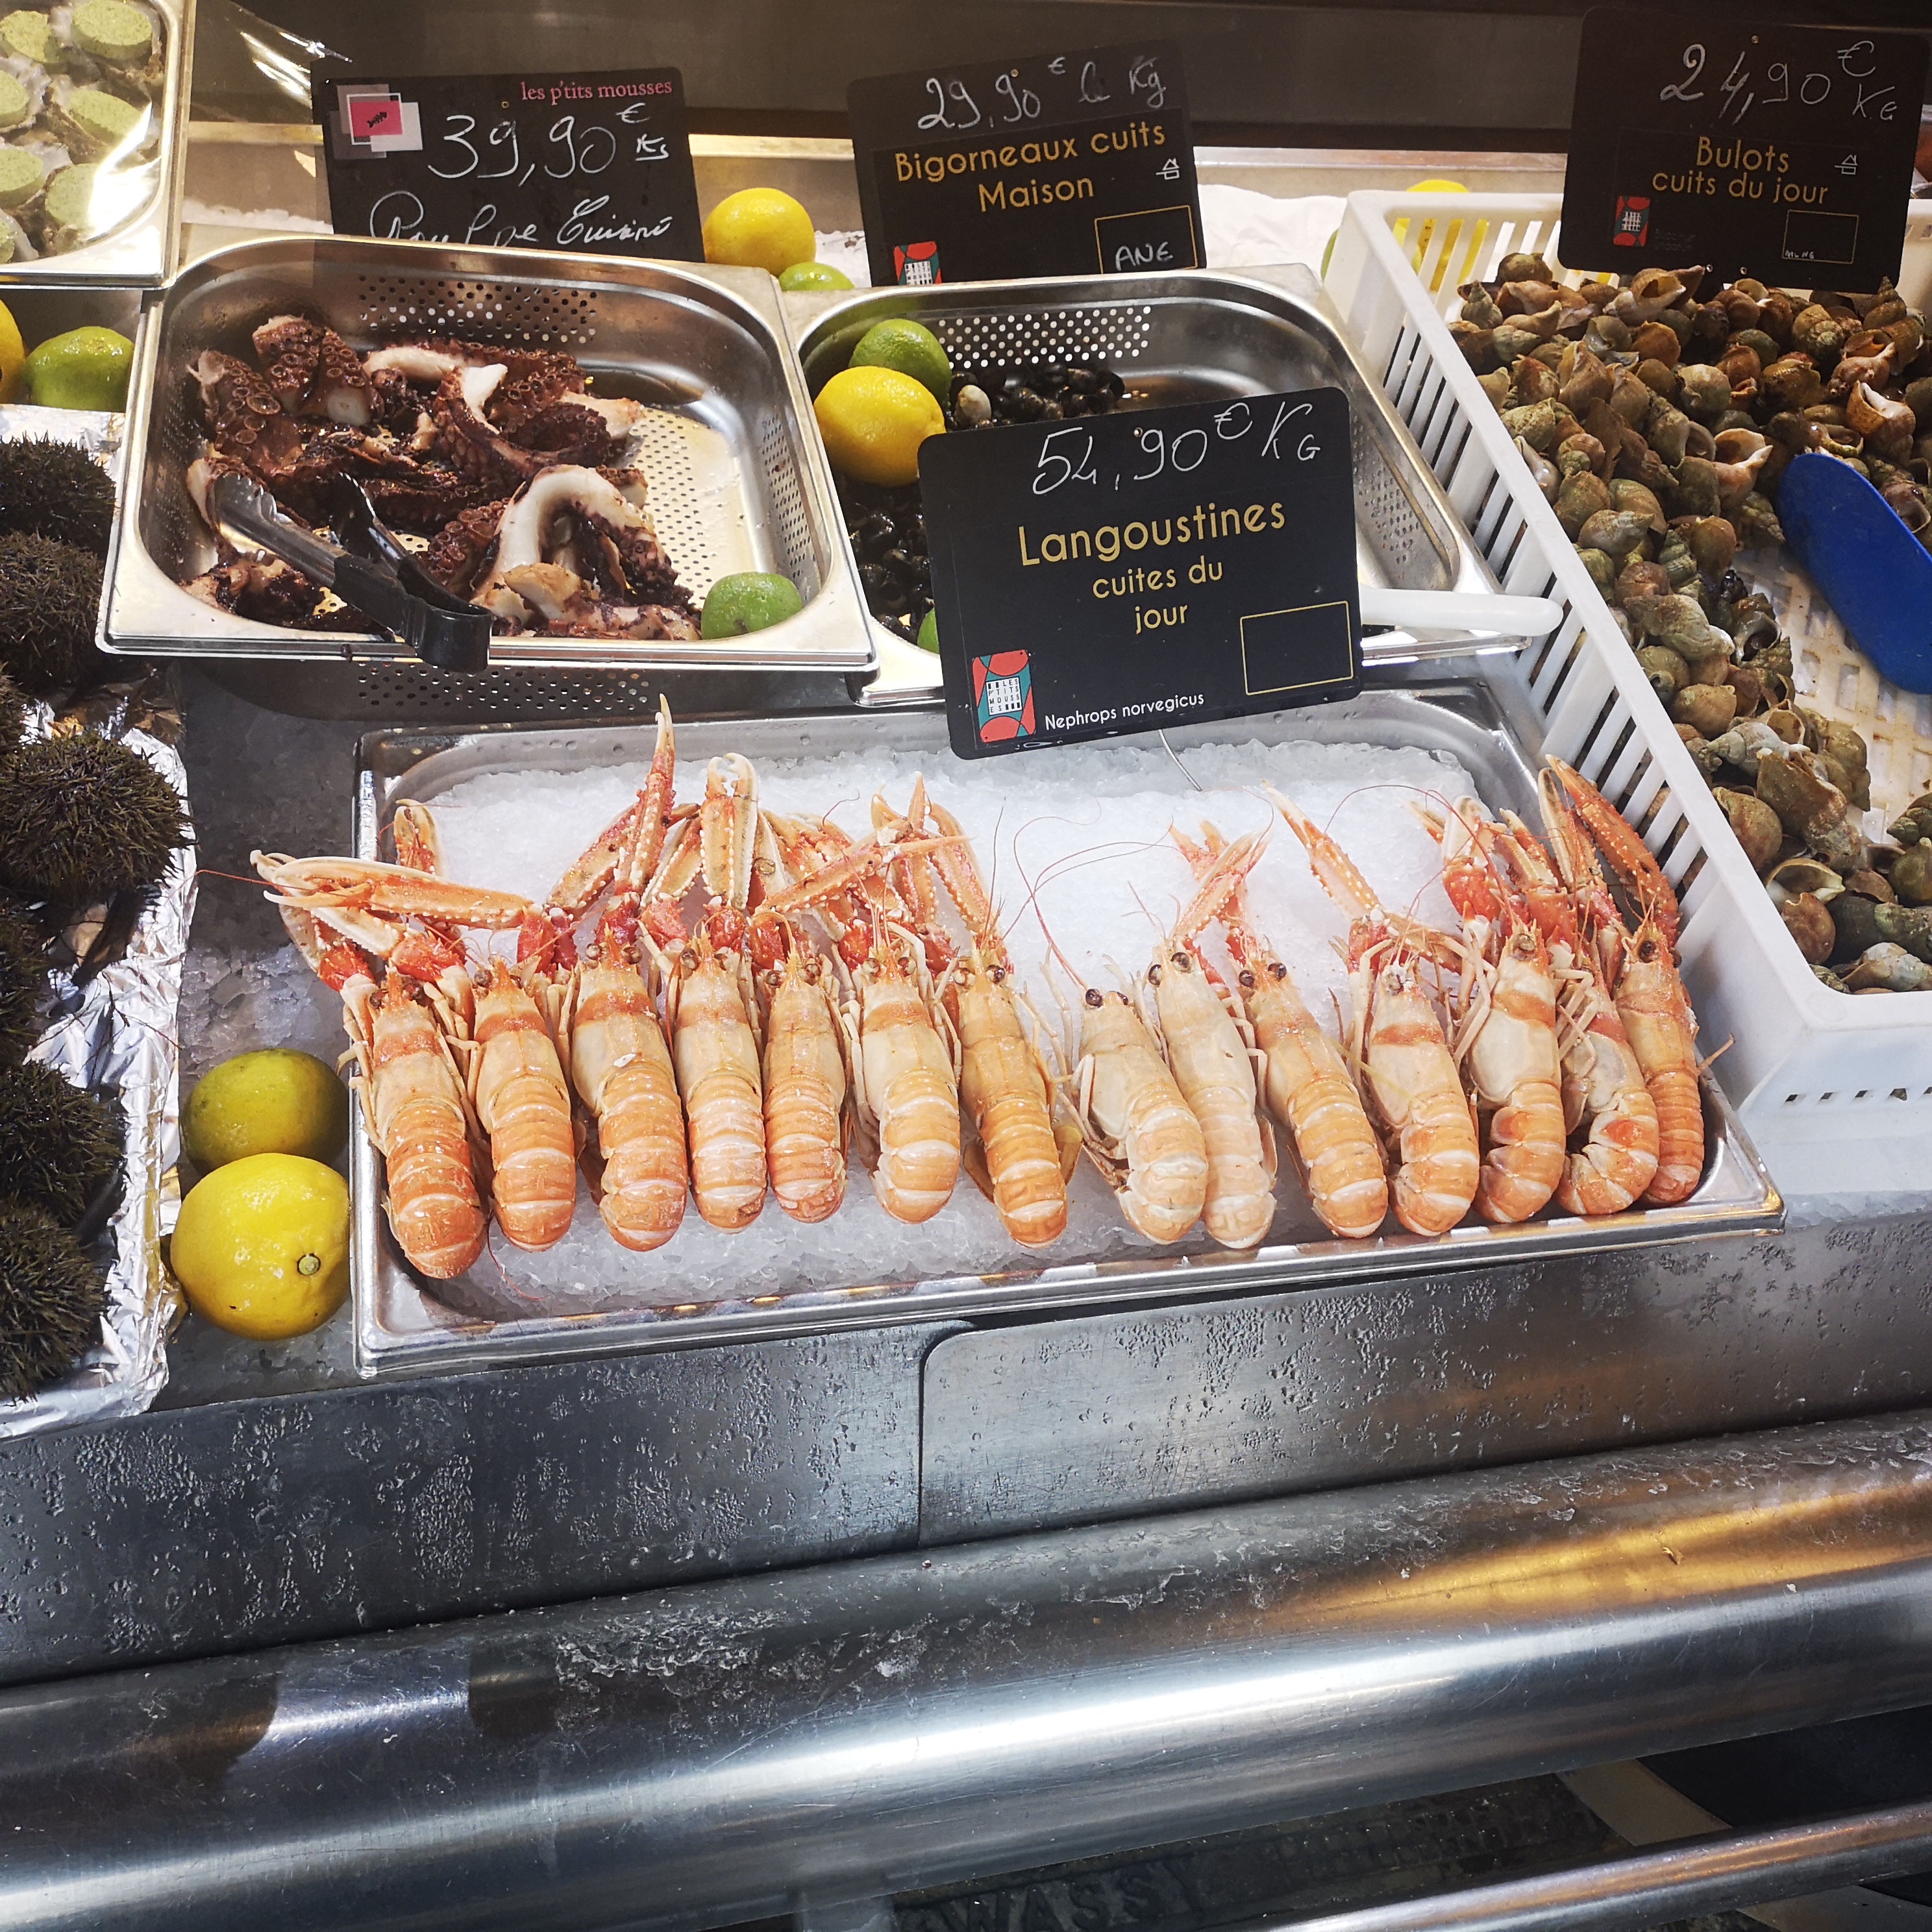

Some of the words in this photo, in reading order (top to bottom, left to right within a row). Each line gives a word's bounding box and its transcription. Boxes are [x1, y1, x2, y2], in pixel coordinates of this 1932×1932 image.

[521, 81, 545, 100] les
[597, 82, 673, 98] mousses
[895, 138, 1078, 182] Bigorneaux
[1091, 121, 1165, 153] cuits
[1696, 136, 1789, 173] Bulots
[978, 178, 1093, 212] Maison
[1652, 170, 1716, 195] cuits
[1728, 171, 1763, 199] du
[1773, 177, 1828, 204] jour
[1115, 242, 1174, 271] ANE
[1019, 502, 1285, 566] Langoustines
[1093, 567, 1176, 599] cuites
[1188, 555, 1222, 584] du
[1135, 604, 1188, 635] jour
[1045, 708, 1117, 731] Nephrops
[1122, 694, 1204, 717] norvegicus
